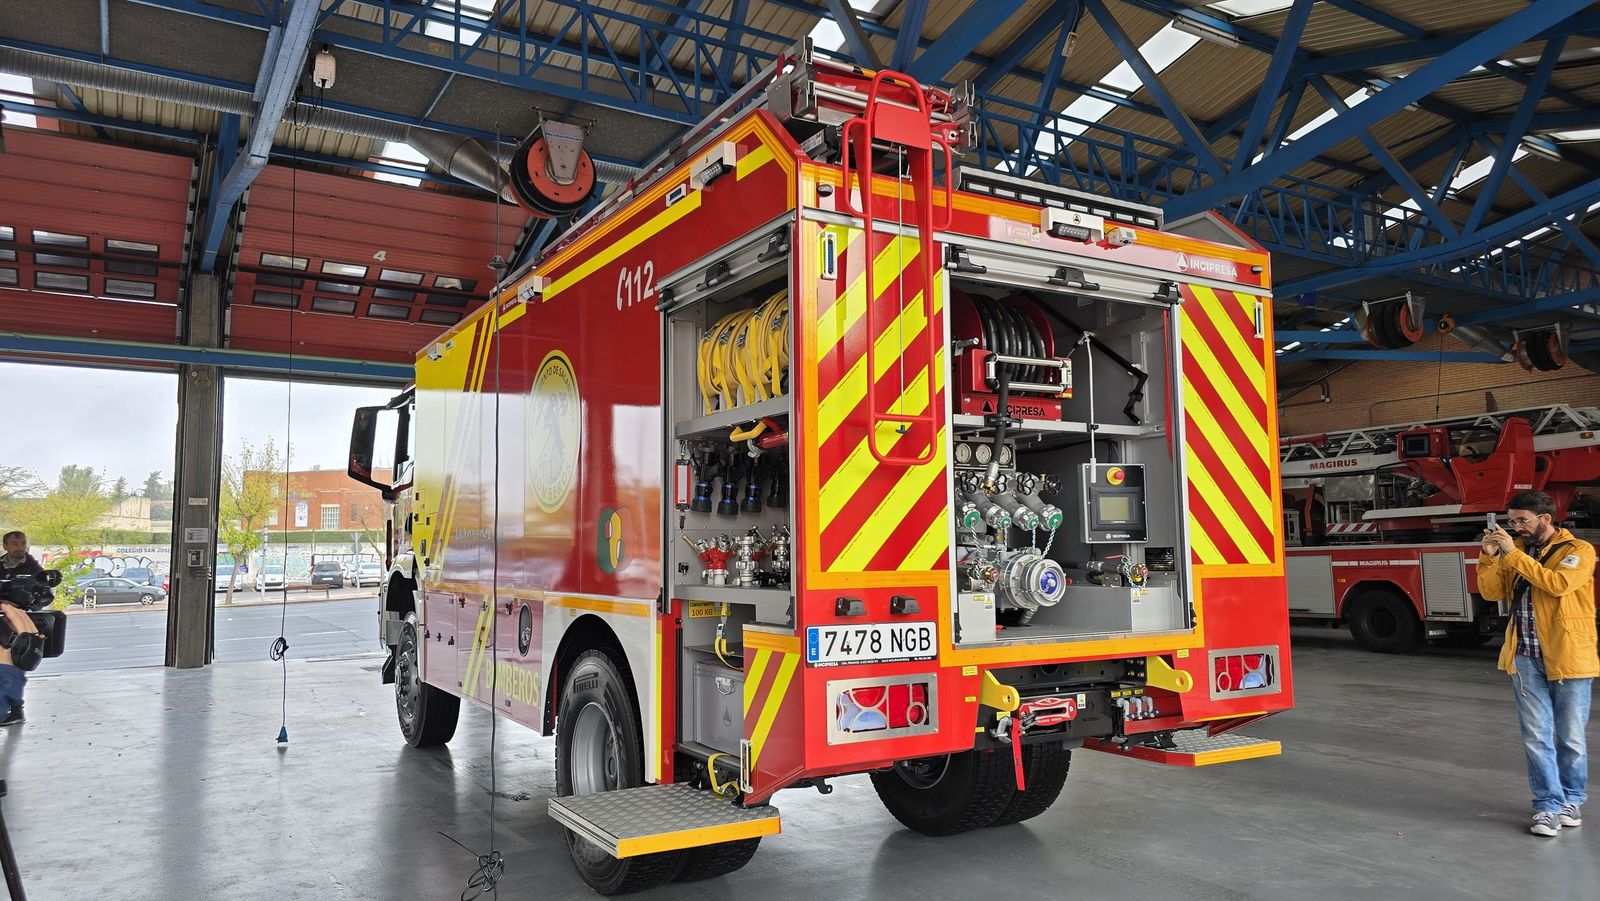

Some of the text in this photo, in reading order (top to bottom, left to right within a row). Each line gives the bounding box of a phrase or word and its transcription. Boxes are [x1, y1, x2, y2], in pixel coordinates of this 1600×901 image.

[373, 250, 387, 261] 4
[1190, 259, 1237, 277] INCIPRESA
[625, 260, 654, 307] 112
[1006, 405, 1046, 417] CIPRESA
[1310, 459, 1358, 470] MAGIRUS
[704, 608, 713, 616] KG
[825, 627, 931, 656] 7478 NGB
[811, 648, 816, 656] E
[485, 658, 539, 707] BMBEROS
[573, 672, 600, 694] PIRELLI
